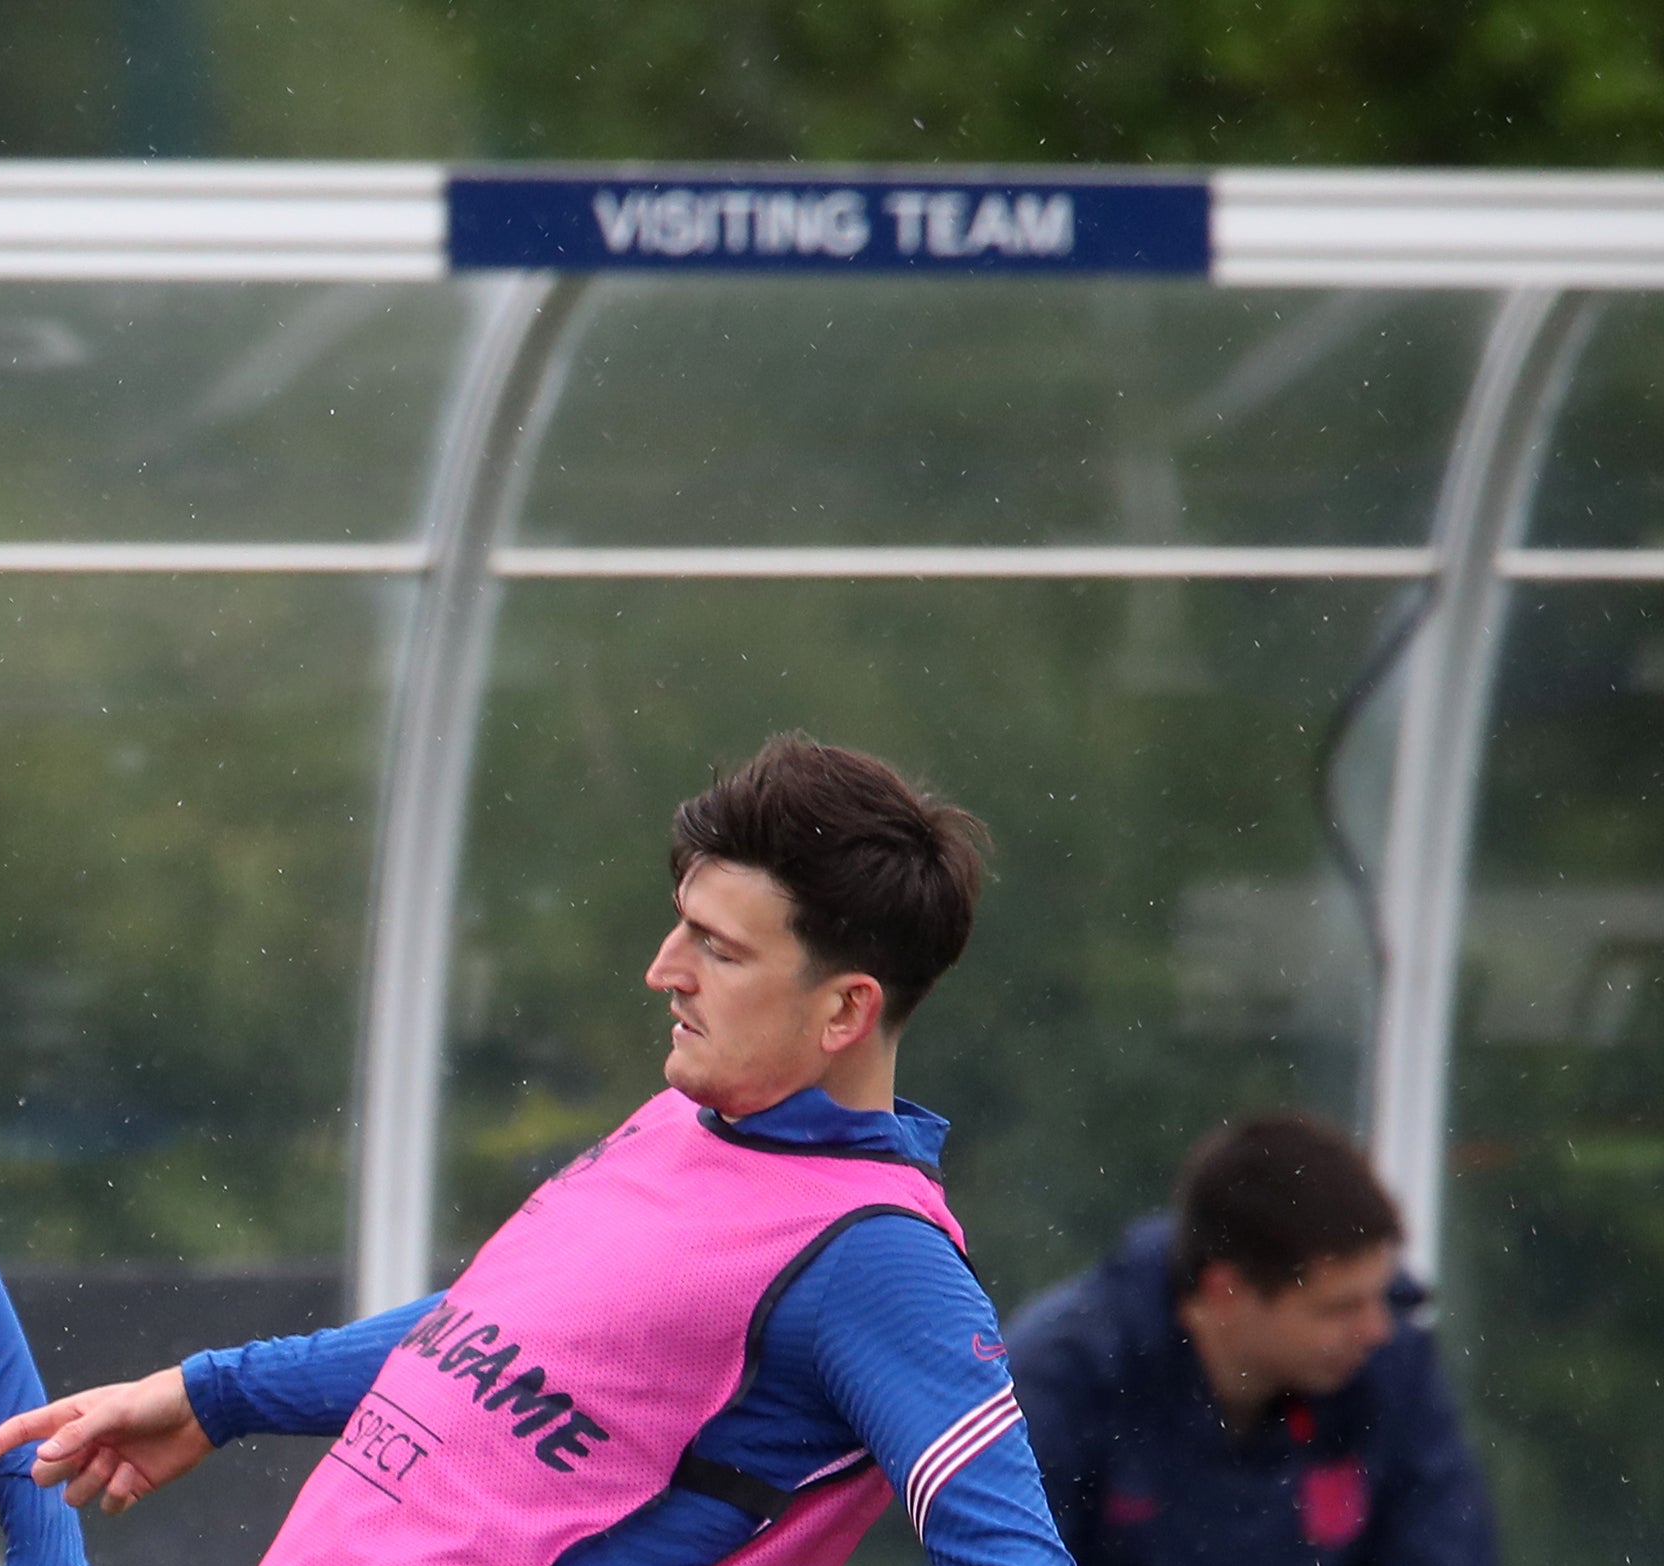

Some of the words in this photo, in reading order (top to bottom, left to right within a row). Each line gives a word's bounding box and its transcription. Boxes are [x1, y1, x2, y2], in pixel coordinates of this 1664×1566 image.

[593, 188, 869, 257] VISITING
[885, 191, 1074, 259] TEAM
[437, 1323, 611, 1474] GAME
[343, 1407, 430, 1482] SPECT
